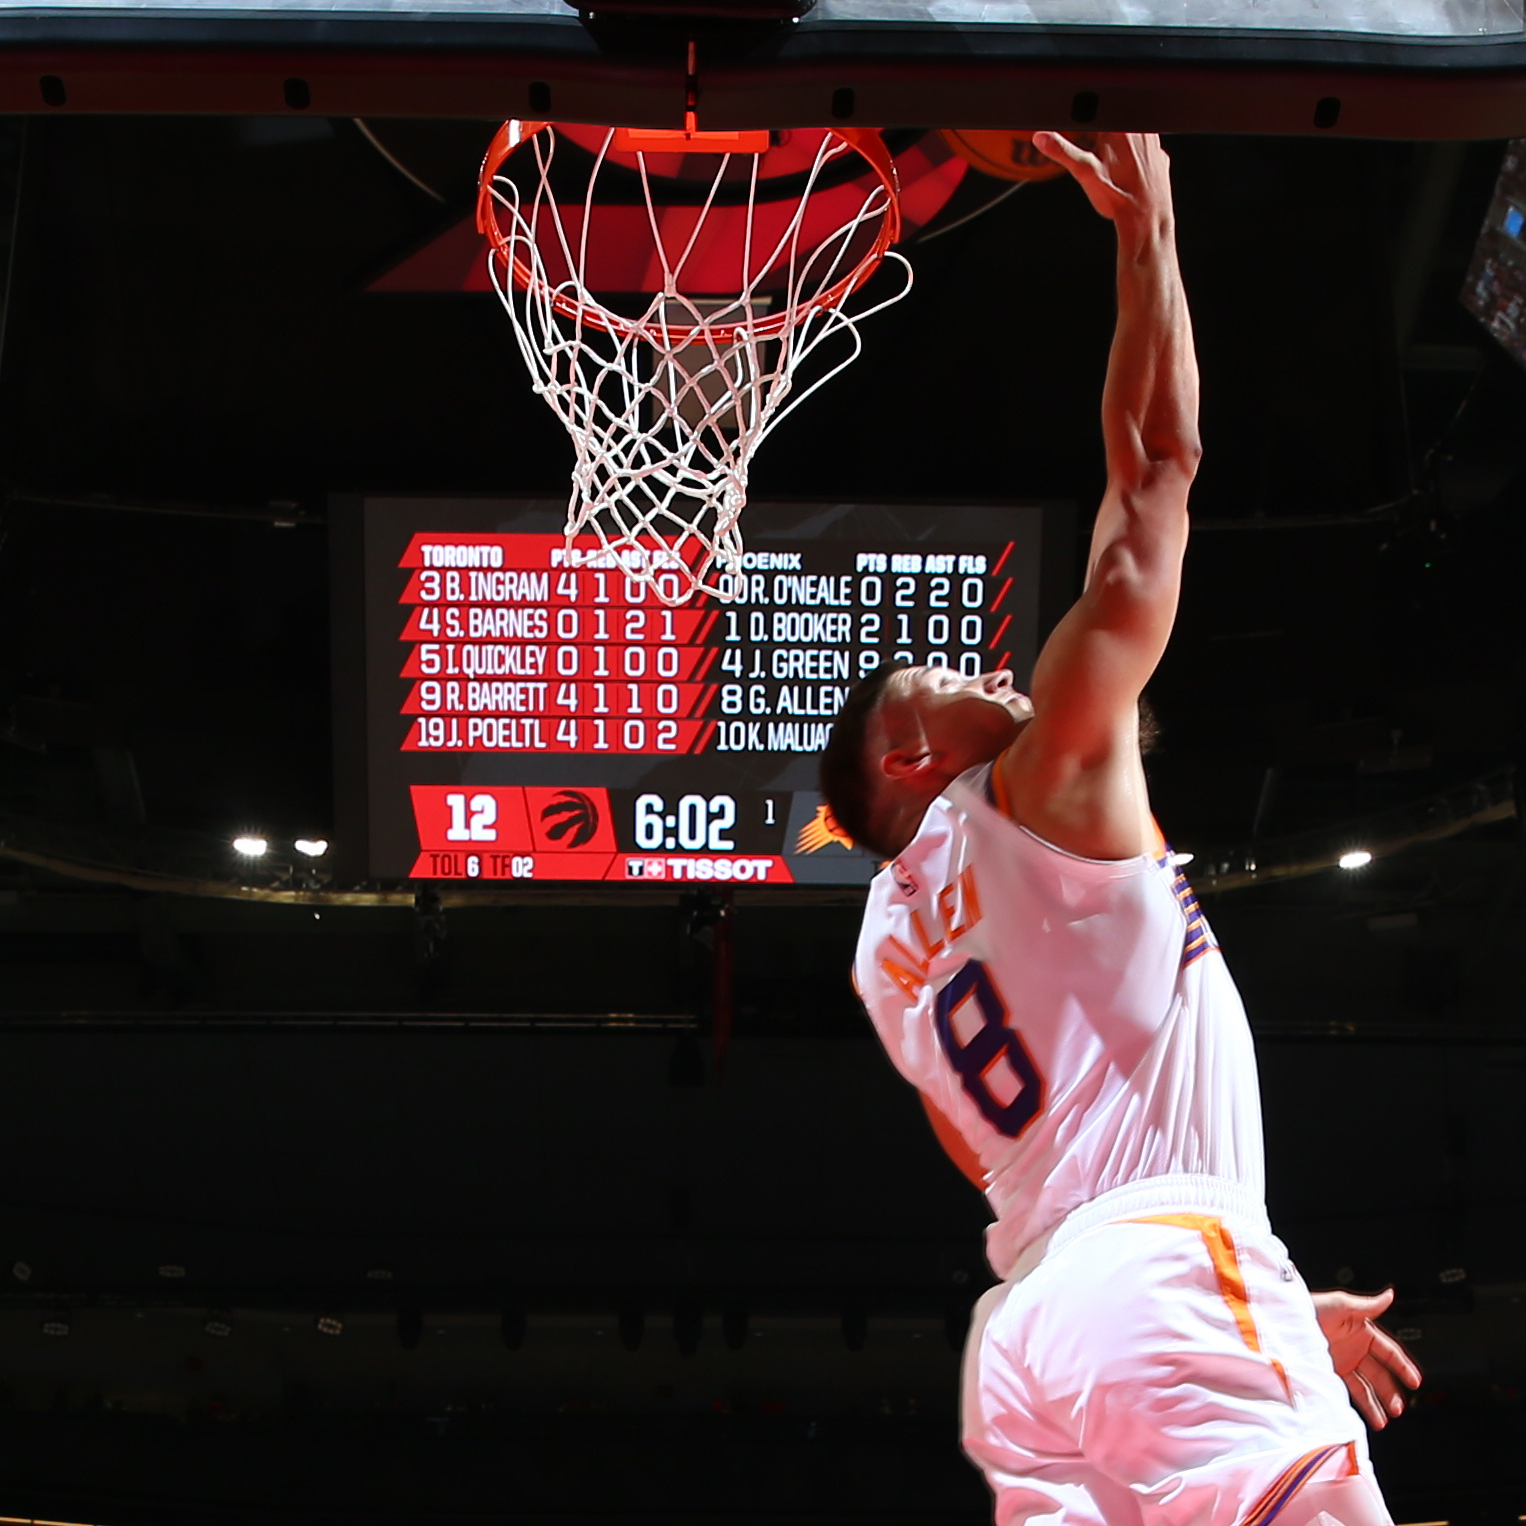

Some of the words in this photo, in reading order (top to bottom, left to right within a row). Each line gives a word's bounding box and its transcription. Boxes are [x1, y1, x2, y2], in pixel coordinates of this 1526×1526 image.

[421, 545, 504, 568] TORONTO
[715, 553, 803, 571] POENIX
[856, 553, 887, 573] PTS
[891, 554, 923, 574] REB
[924, 555, 956, 574] AST
[958, 555, 988, 575] FLS
[420, 571, 441, 601] 3
[445, 572, 465, 602] B.
[468, 572, 549, 602] INGRAM
[556, 573, 579, 603] 4
[593, 573, 610, 603] 1
[624, 575, 646, 604] 0
[657, 574, 680, 605] 0
[718, 575, 748, 605] 00
[750, 575, 770, 605] R.
[773, 576, 853, 606] O'NEALE
[860, 576, 882, 607] 0
[894, 577, 916, 608] 2
[929, 577, 950, 608] 2
[961, 577, 984, 608] 0
[419, 607, 441, 638] 4
[445, 608, 465, 638] S.
[468, 608, 549, 639] BARNES
[557, 609, 580, 639] 0
[593, 609, 610, 640] 1
[624, 609, 646, 640] 2
[659, 610, 677, 640] 1
[724, 611, 741, 642] 1
[749, 612, 769, 642] D.
[772, 612, 852, 643] BOOKER
[859, 613, 881, 644] 2
[896, 614, 913, 644] 1
[927, 614, 950, 645] 0
[960, 615, 983, 645] 0
[420, 644, 441, 675] 5
[461, 645, 547, 679] QUICKLEY
[557, 646, 580, 676] 0
[593, 646, 610, 677] 1
[624, 646, 646, 677] 0
[657, 647, 679, 678] 0
[720, 648, 743, 679] 4
[748, 649, 767, 679] J.
[772, 649, 850, 680] GREEN
[960, 651, 982, 680] 0
[420, 681, 441, 712] 9
[446, 682, 465, 712] R.
[467, 682, 548, 712] BARRETT
[556, 683, 579, 712] 4
[593, 683, 610, 713] 1
[626, 683, 644, 714] 1
[657, 684, 679, 714] 0
[721, 684, 743, 715] 8
[749, 685, 772, 715] G.
[775, 685, 850, 716] ALLEN
[417, 717, 445, 747] 19
[446, 718, 463, 748] J.
[468, 718, 547, 748] POELTL
[556, 719, 579, 749] 4
[593, 719, 610, 749] 1
[623, 719, 646, 750] 0
[657, 720, 679, 750] 2
[716, 721, 746, 751] 10
[747, 721, 765, 751] K.
[445, 793, 497, 842] 12
[634, 793, 736, 851] 6:02
[764, 799, 776, 826] 1
[428, 853, 463, 877] TOL
[466, 856, 481, 879] 6
[510, 856, 535, 879] 02
[667, 858, 774, 881] TISSOT
[935, 957, 1047, 1140] 8
